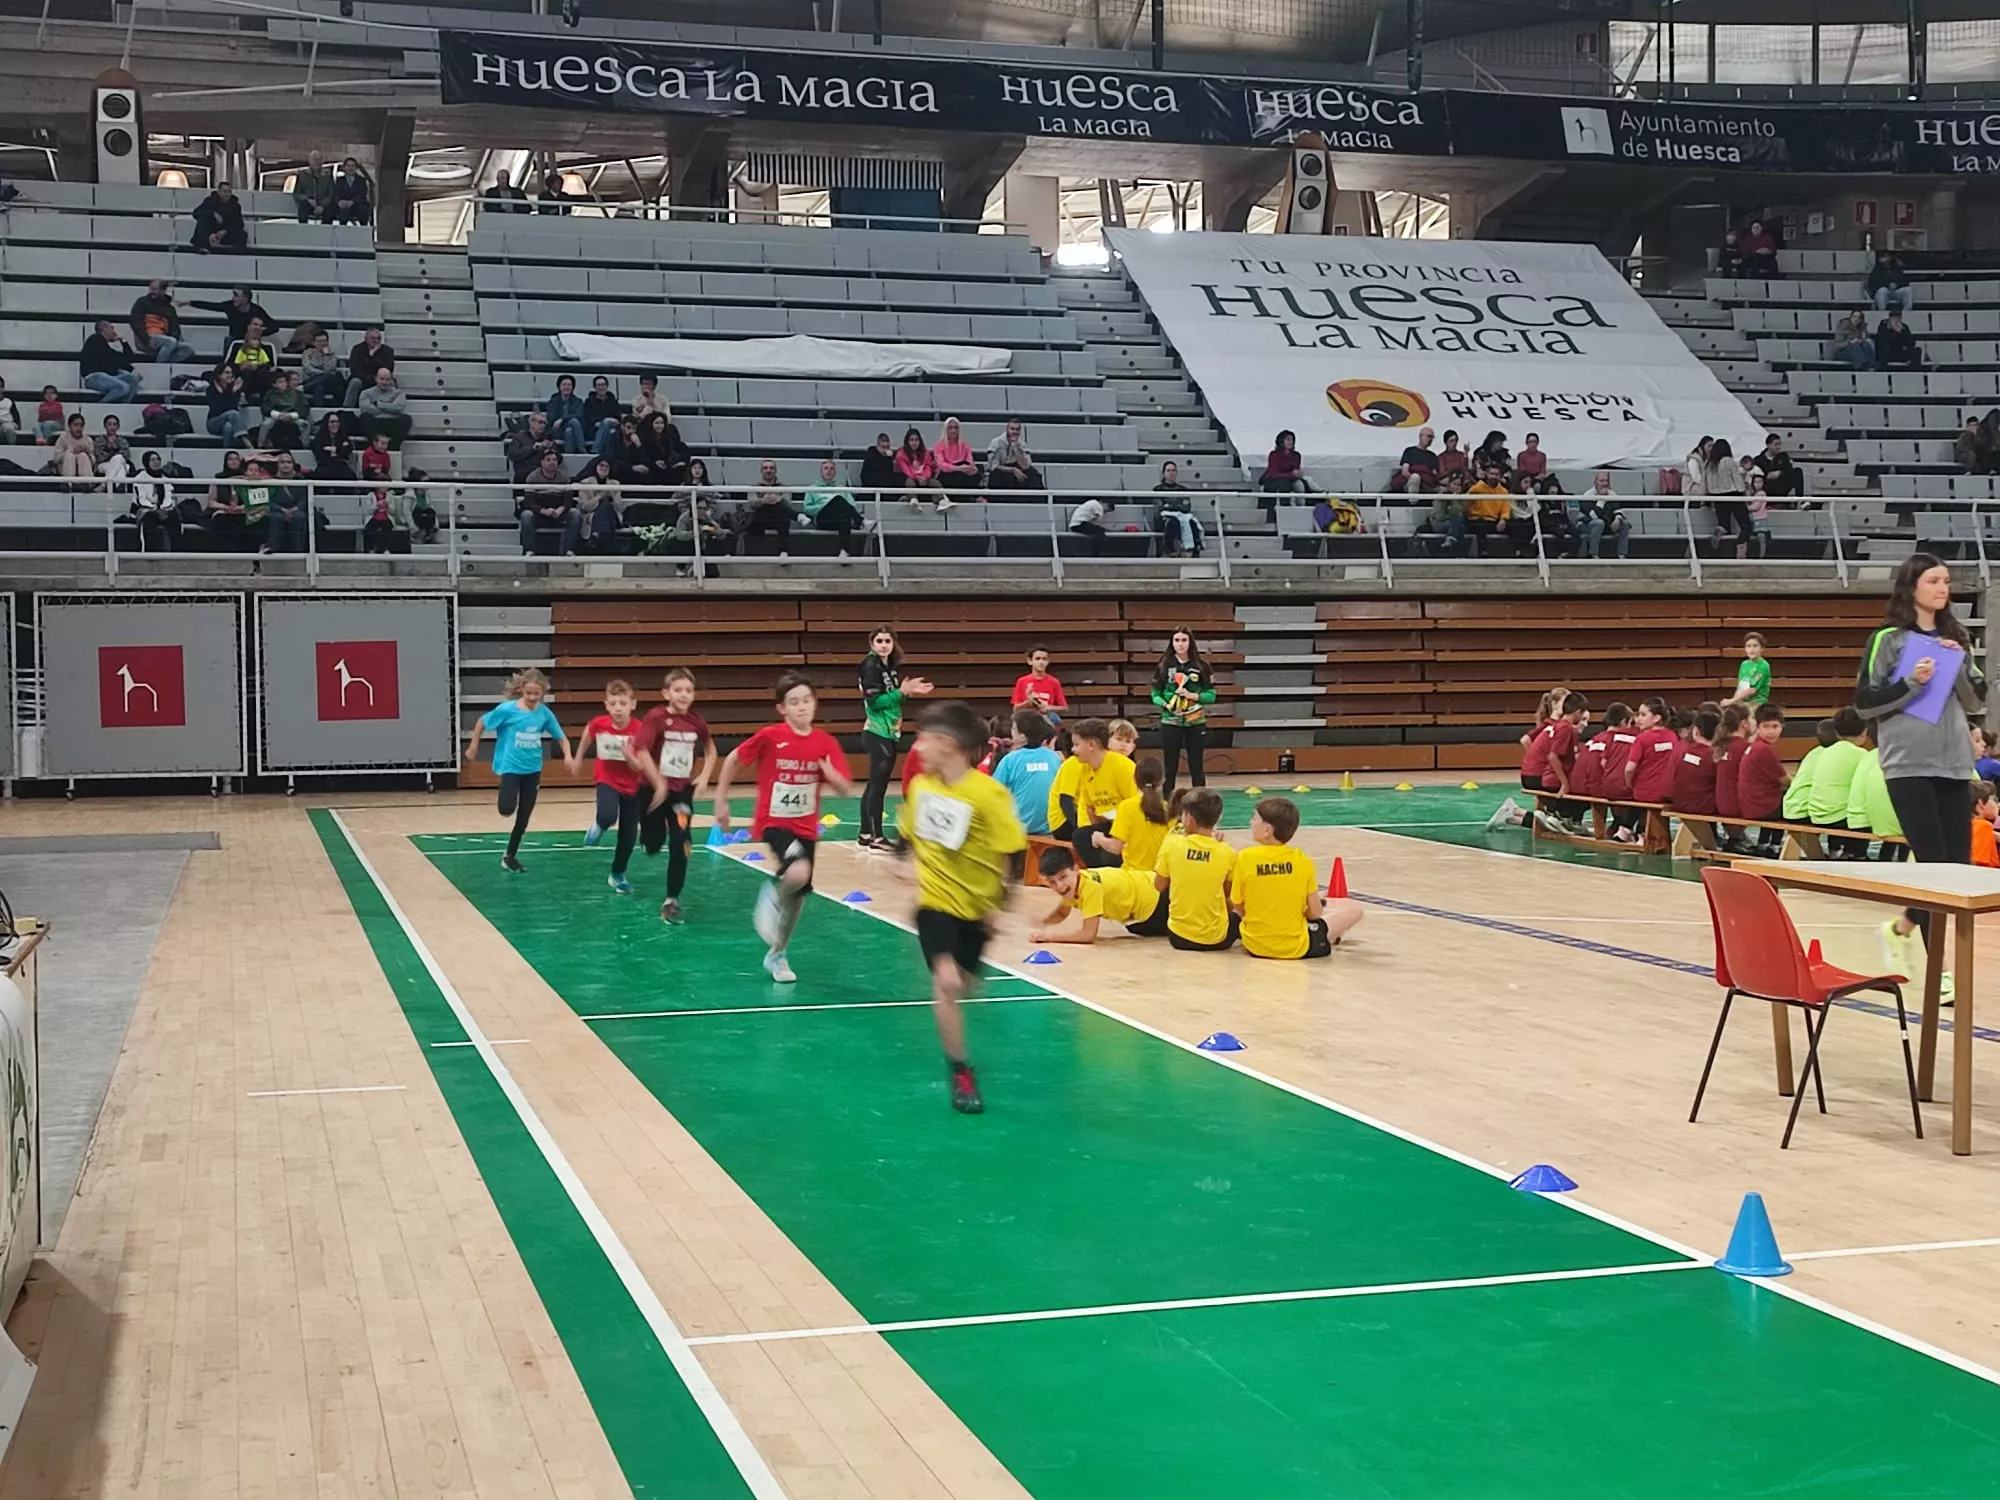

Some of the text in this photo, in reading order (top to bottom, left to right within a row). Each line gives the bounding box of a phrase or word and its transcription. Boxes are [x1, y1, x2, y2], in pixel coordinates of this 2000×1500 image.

[471, 52, 691, 99] Huesca
[704, 69, 765, 103] La
[999, 74, 1180, 113] Huesca
[1038, 116, 1068, 133] La
[1619, 109, 1775, 137] Ayuntamiento
[1622, 136, 1741, 163] de Huesca
[1952, 155, 1981, 173] La
[1190, 284, 1618, 328] Huesca
[1275, 322, 1361, 349] La
[1451, 406, 1644, 421] HUESCA
[1256, 862, 1293, 876] NACHO
